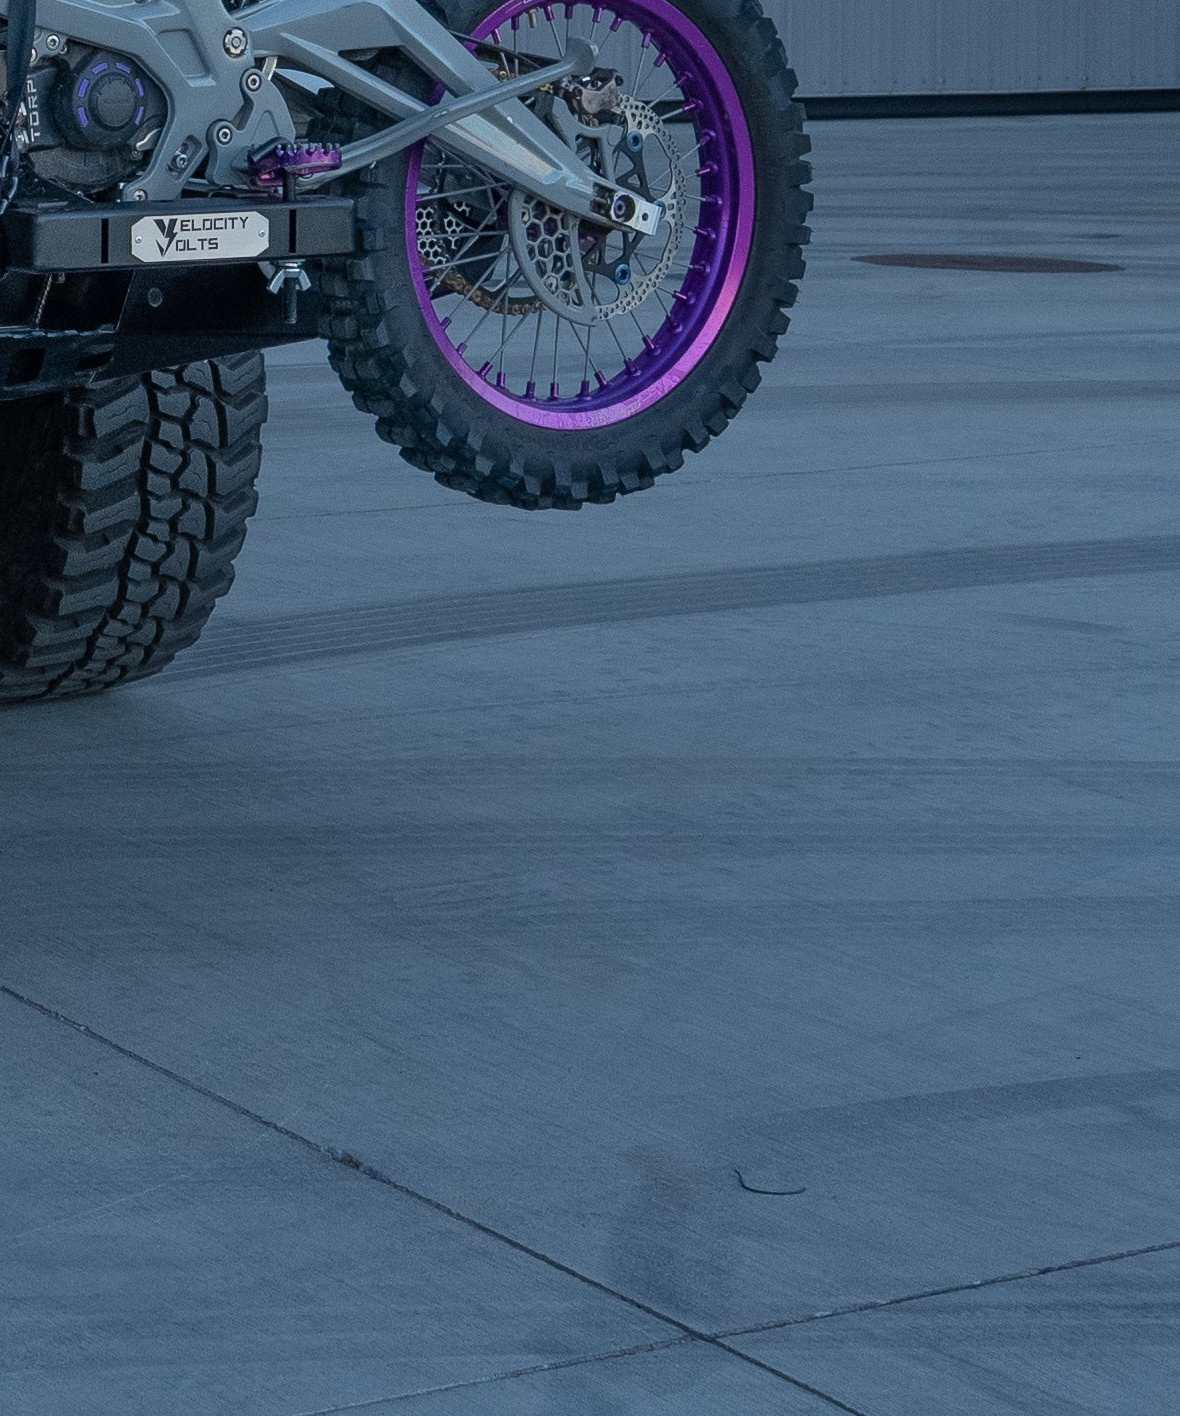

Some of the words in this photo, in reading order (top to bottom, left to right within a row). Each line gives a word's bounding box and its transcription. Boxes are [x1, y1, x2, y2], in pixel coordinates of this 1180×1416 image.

[26, 79, 41, 142] TORP
[153, 216, 249, 238] VELOCITY
[155, 232, 219, 257] VOLTS
